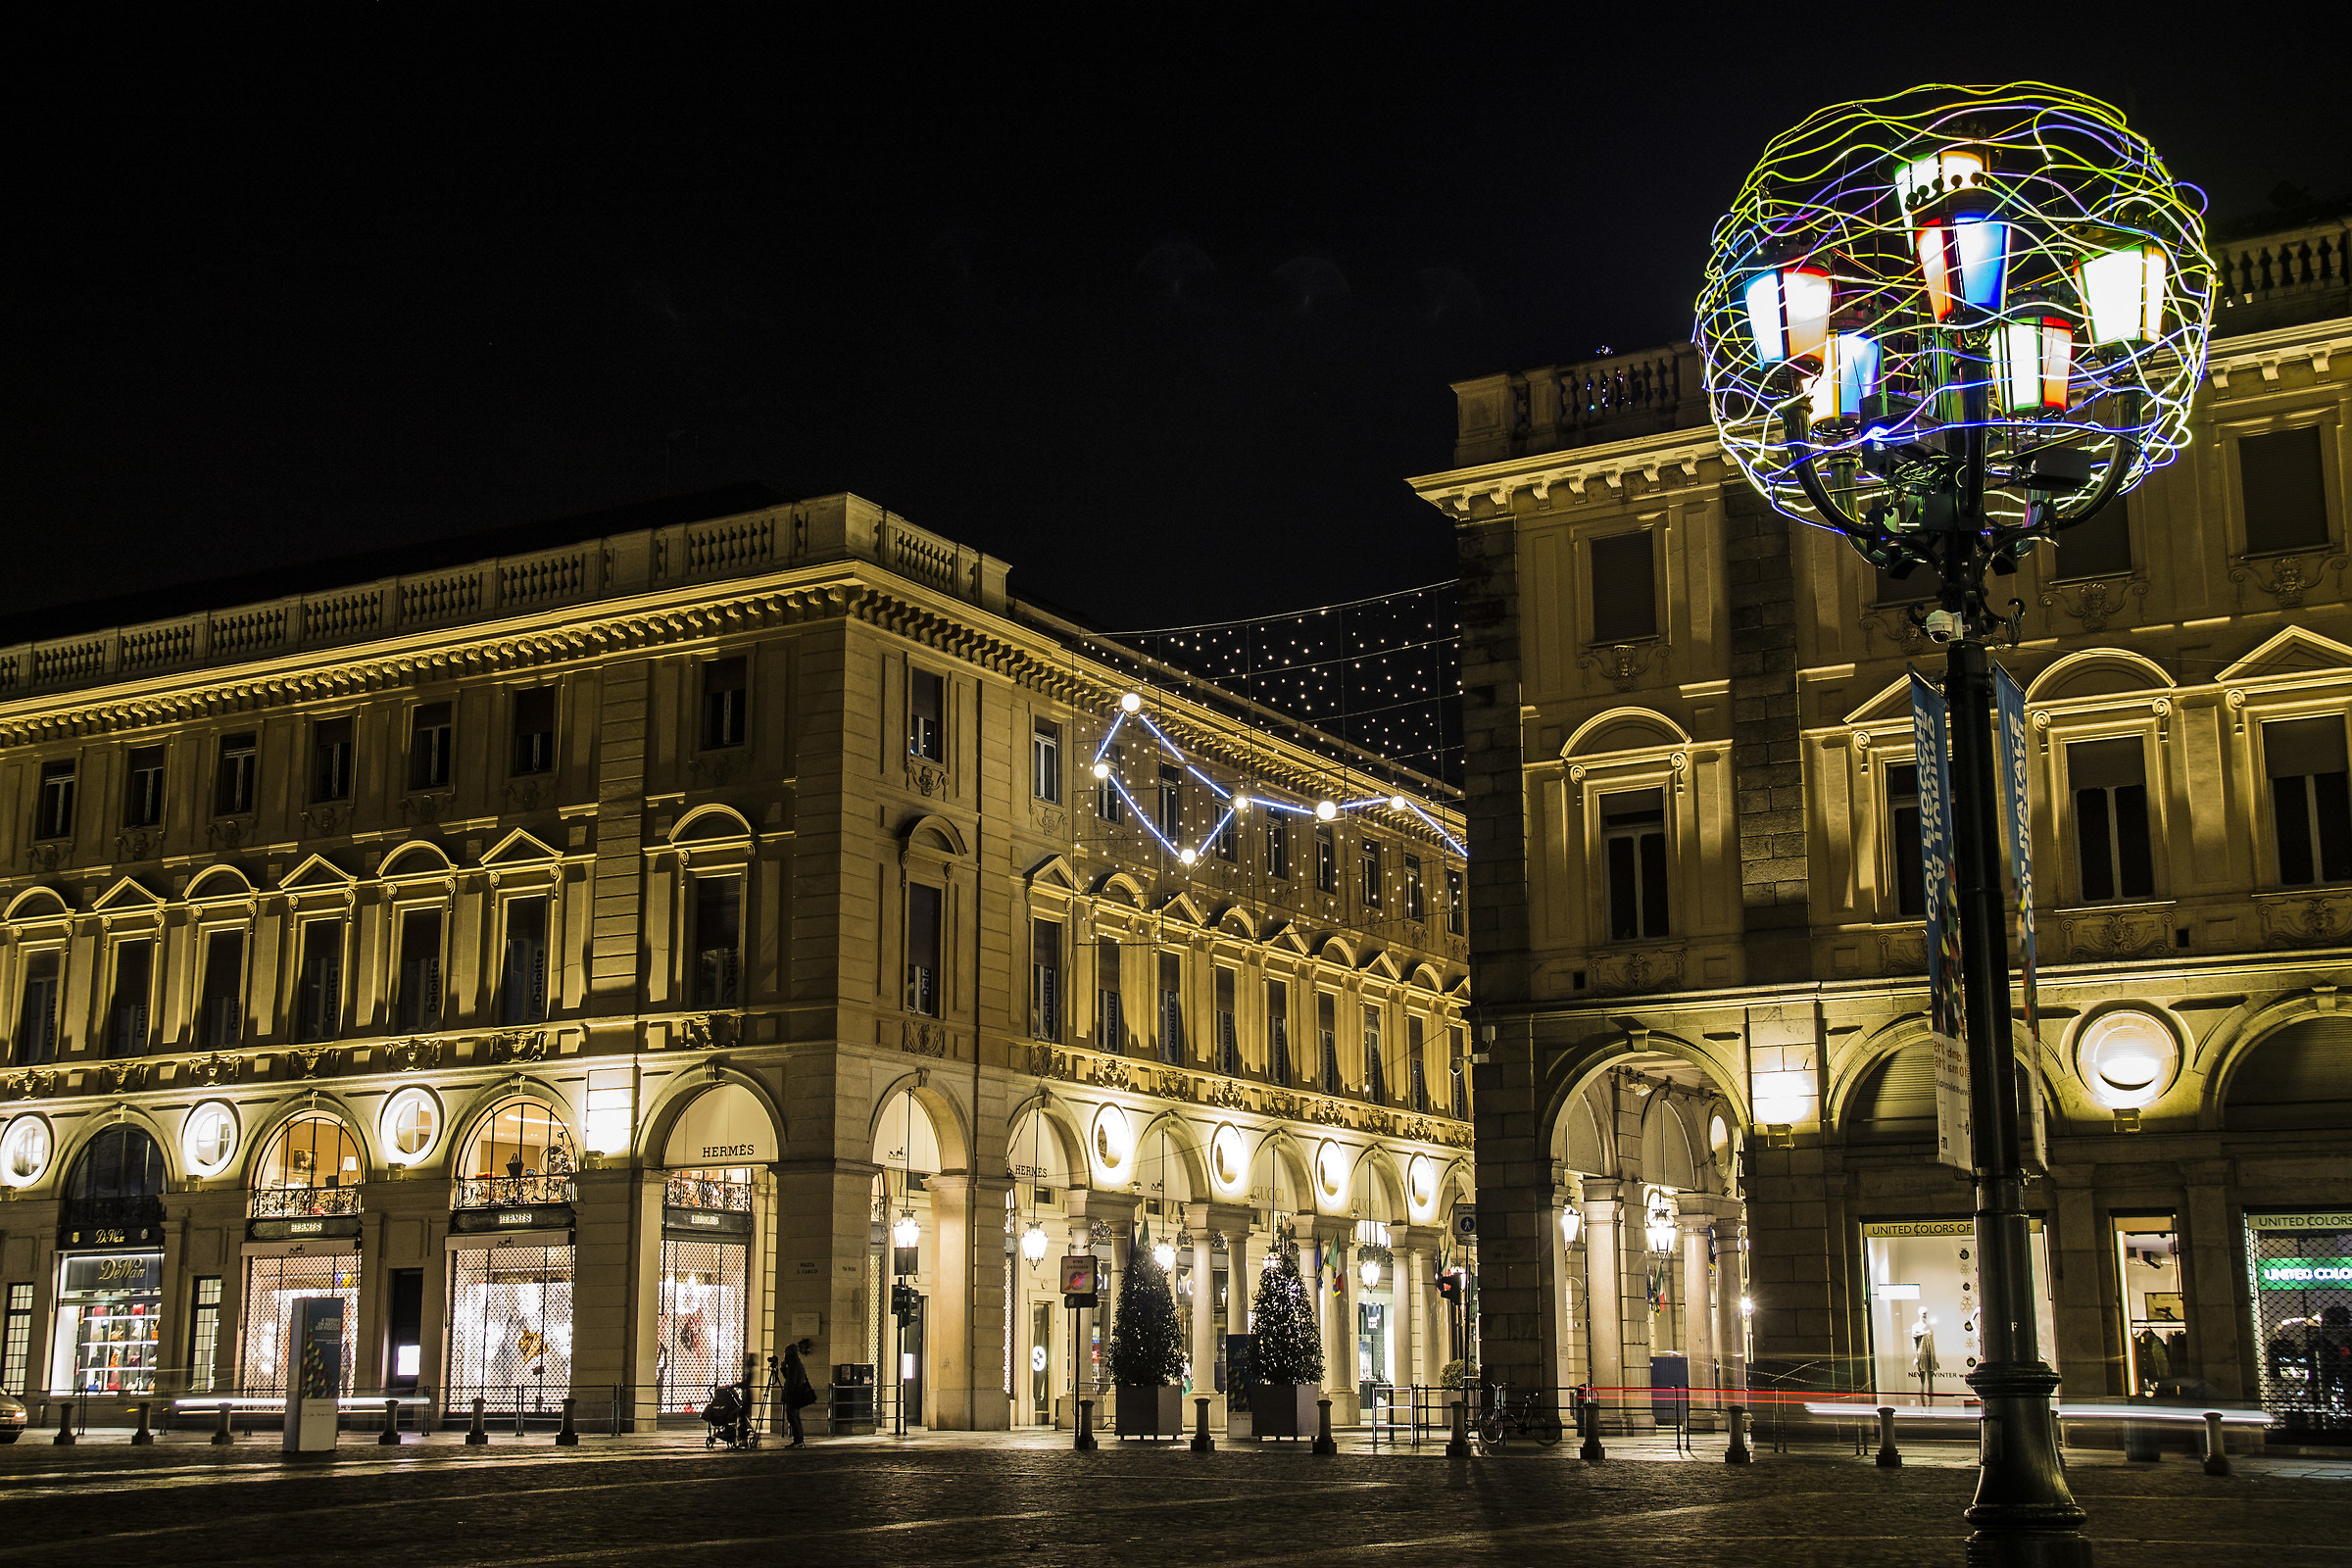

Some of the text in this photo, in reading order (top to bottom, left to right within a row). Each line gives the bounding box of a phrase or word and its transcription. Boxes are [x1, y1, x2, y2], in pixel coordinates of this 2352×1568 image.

[533, 949, 544, 1004] Deloitte
[428, 960, 440, 1012] Deloitte
[328, 969, 339, 1021] Deloitte
[702, 1144, 755, 1158] HERMÈS
[1251, 1186, 1285, 1203] GUCCI
[1350, 1197, 1380, 1214] GUCCI
[1872, 1223, 1972, 1236] UNITED COLORS OF
[2259, 1215, 2352, 1227] UNITED COLORS
[98, 1257, 146, 1280] DeWan
[2264, 1268, 2313, 1281] UNITED
